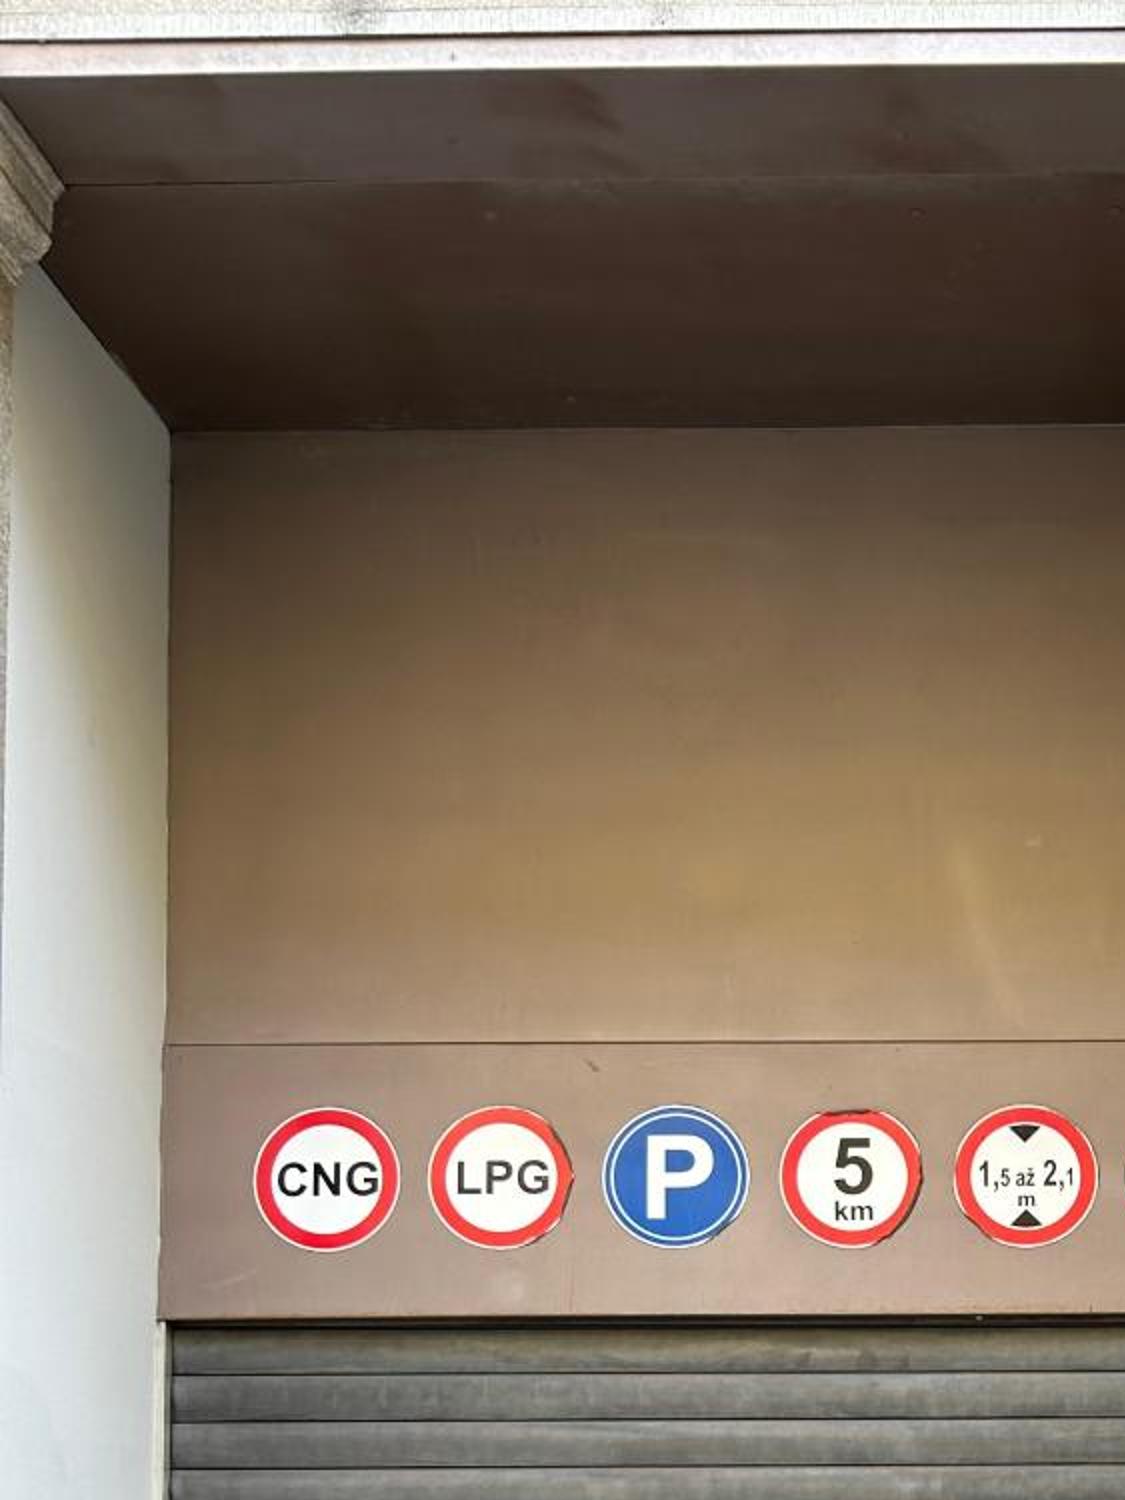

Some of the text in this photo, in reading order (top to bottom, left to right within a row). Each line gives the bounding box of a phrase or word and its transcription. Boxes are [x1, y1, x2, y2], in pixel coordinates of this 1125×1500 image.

[277, 1161, 379, 1197] CNG
[456, 1160, 550, 1195] LPG
[645, 1134, 715, 1220] P
[834, 1137, 873, 1196] 5
[978, 1159, 1074, 1190] 1,5 až 2,1
[835, 1201, 874, 1221] km
[1017, 1194, 1036, 1207] m
